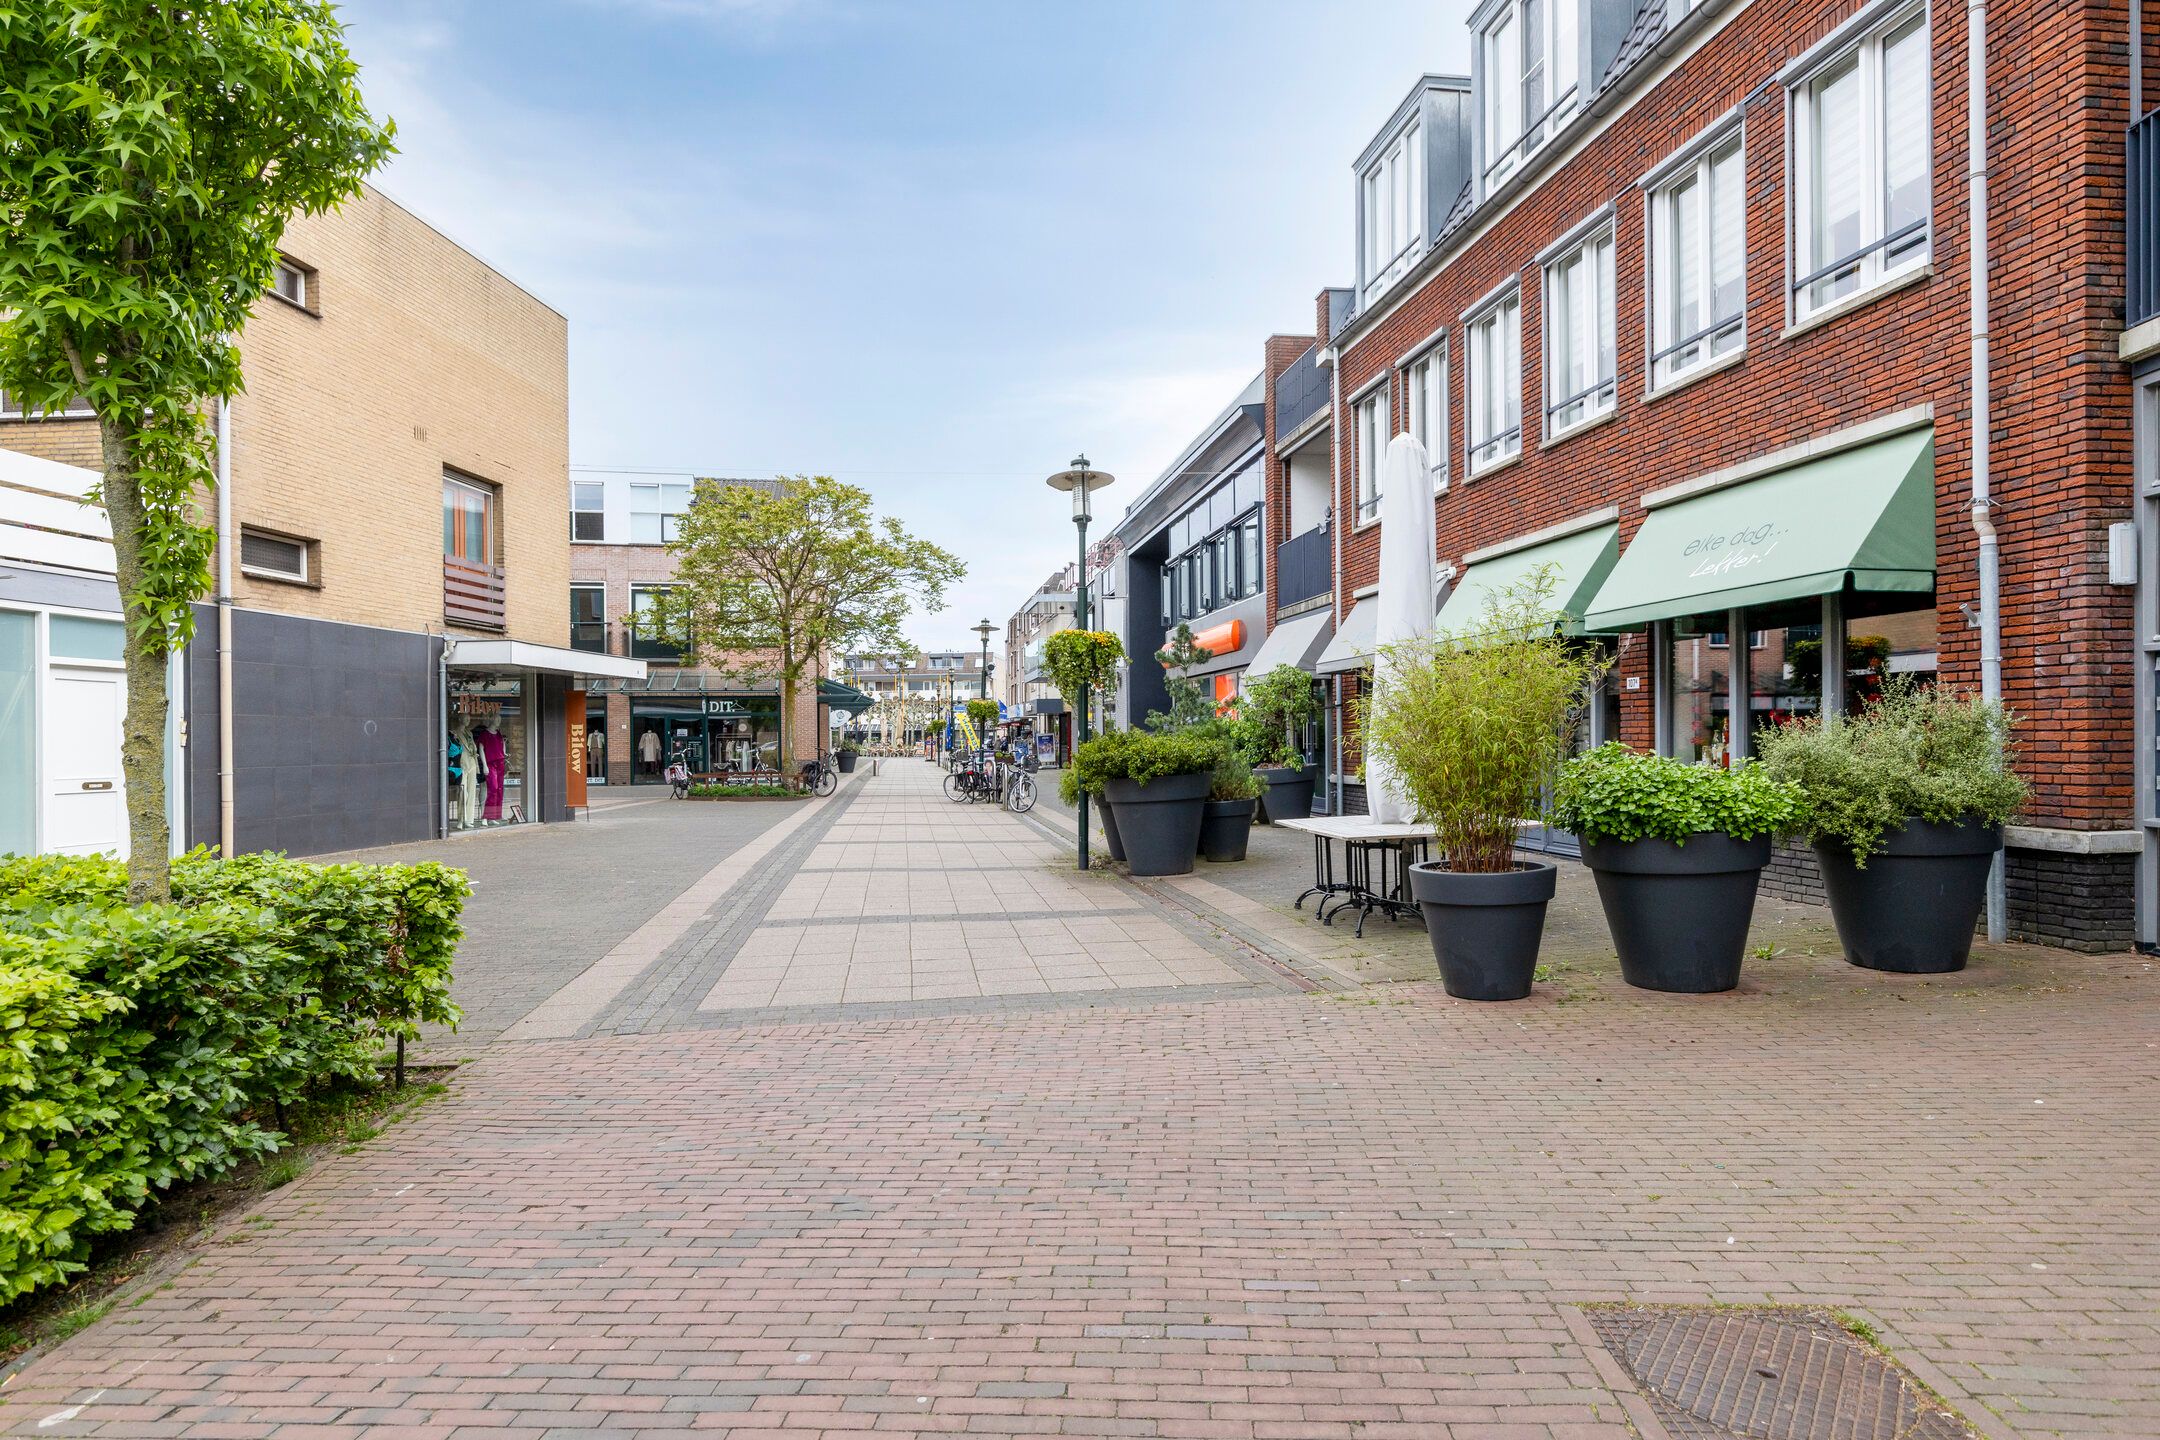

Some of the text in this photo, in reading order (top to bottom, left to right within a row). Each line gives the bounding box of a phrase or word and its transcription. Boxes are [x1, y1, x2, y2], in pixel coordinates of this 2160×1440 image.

[1683, 534, 1725, 557] elke
[459, 693, 504, 714] Bilow
[571, 724, 585, 774] Bilow
